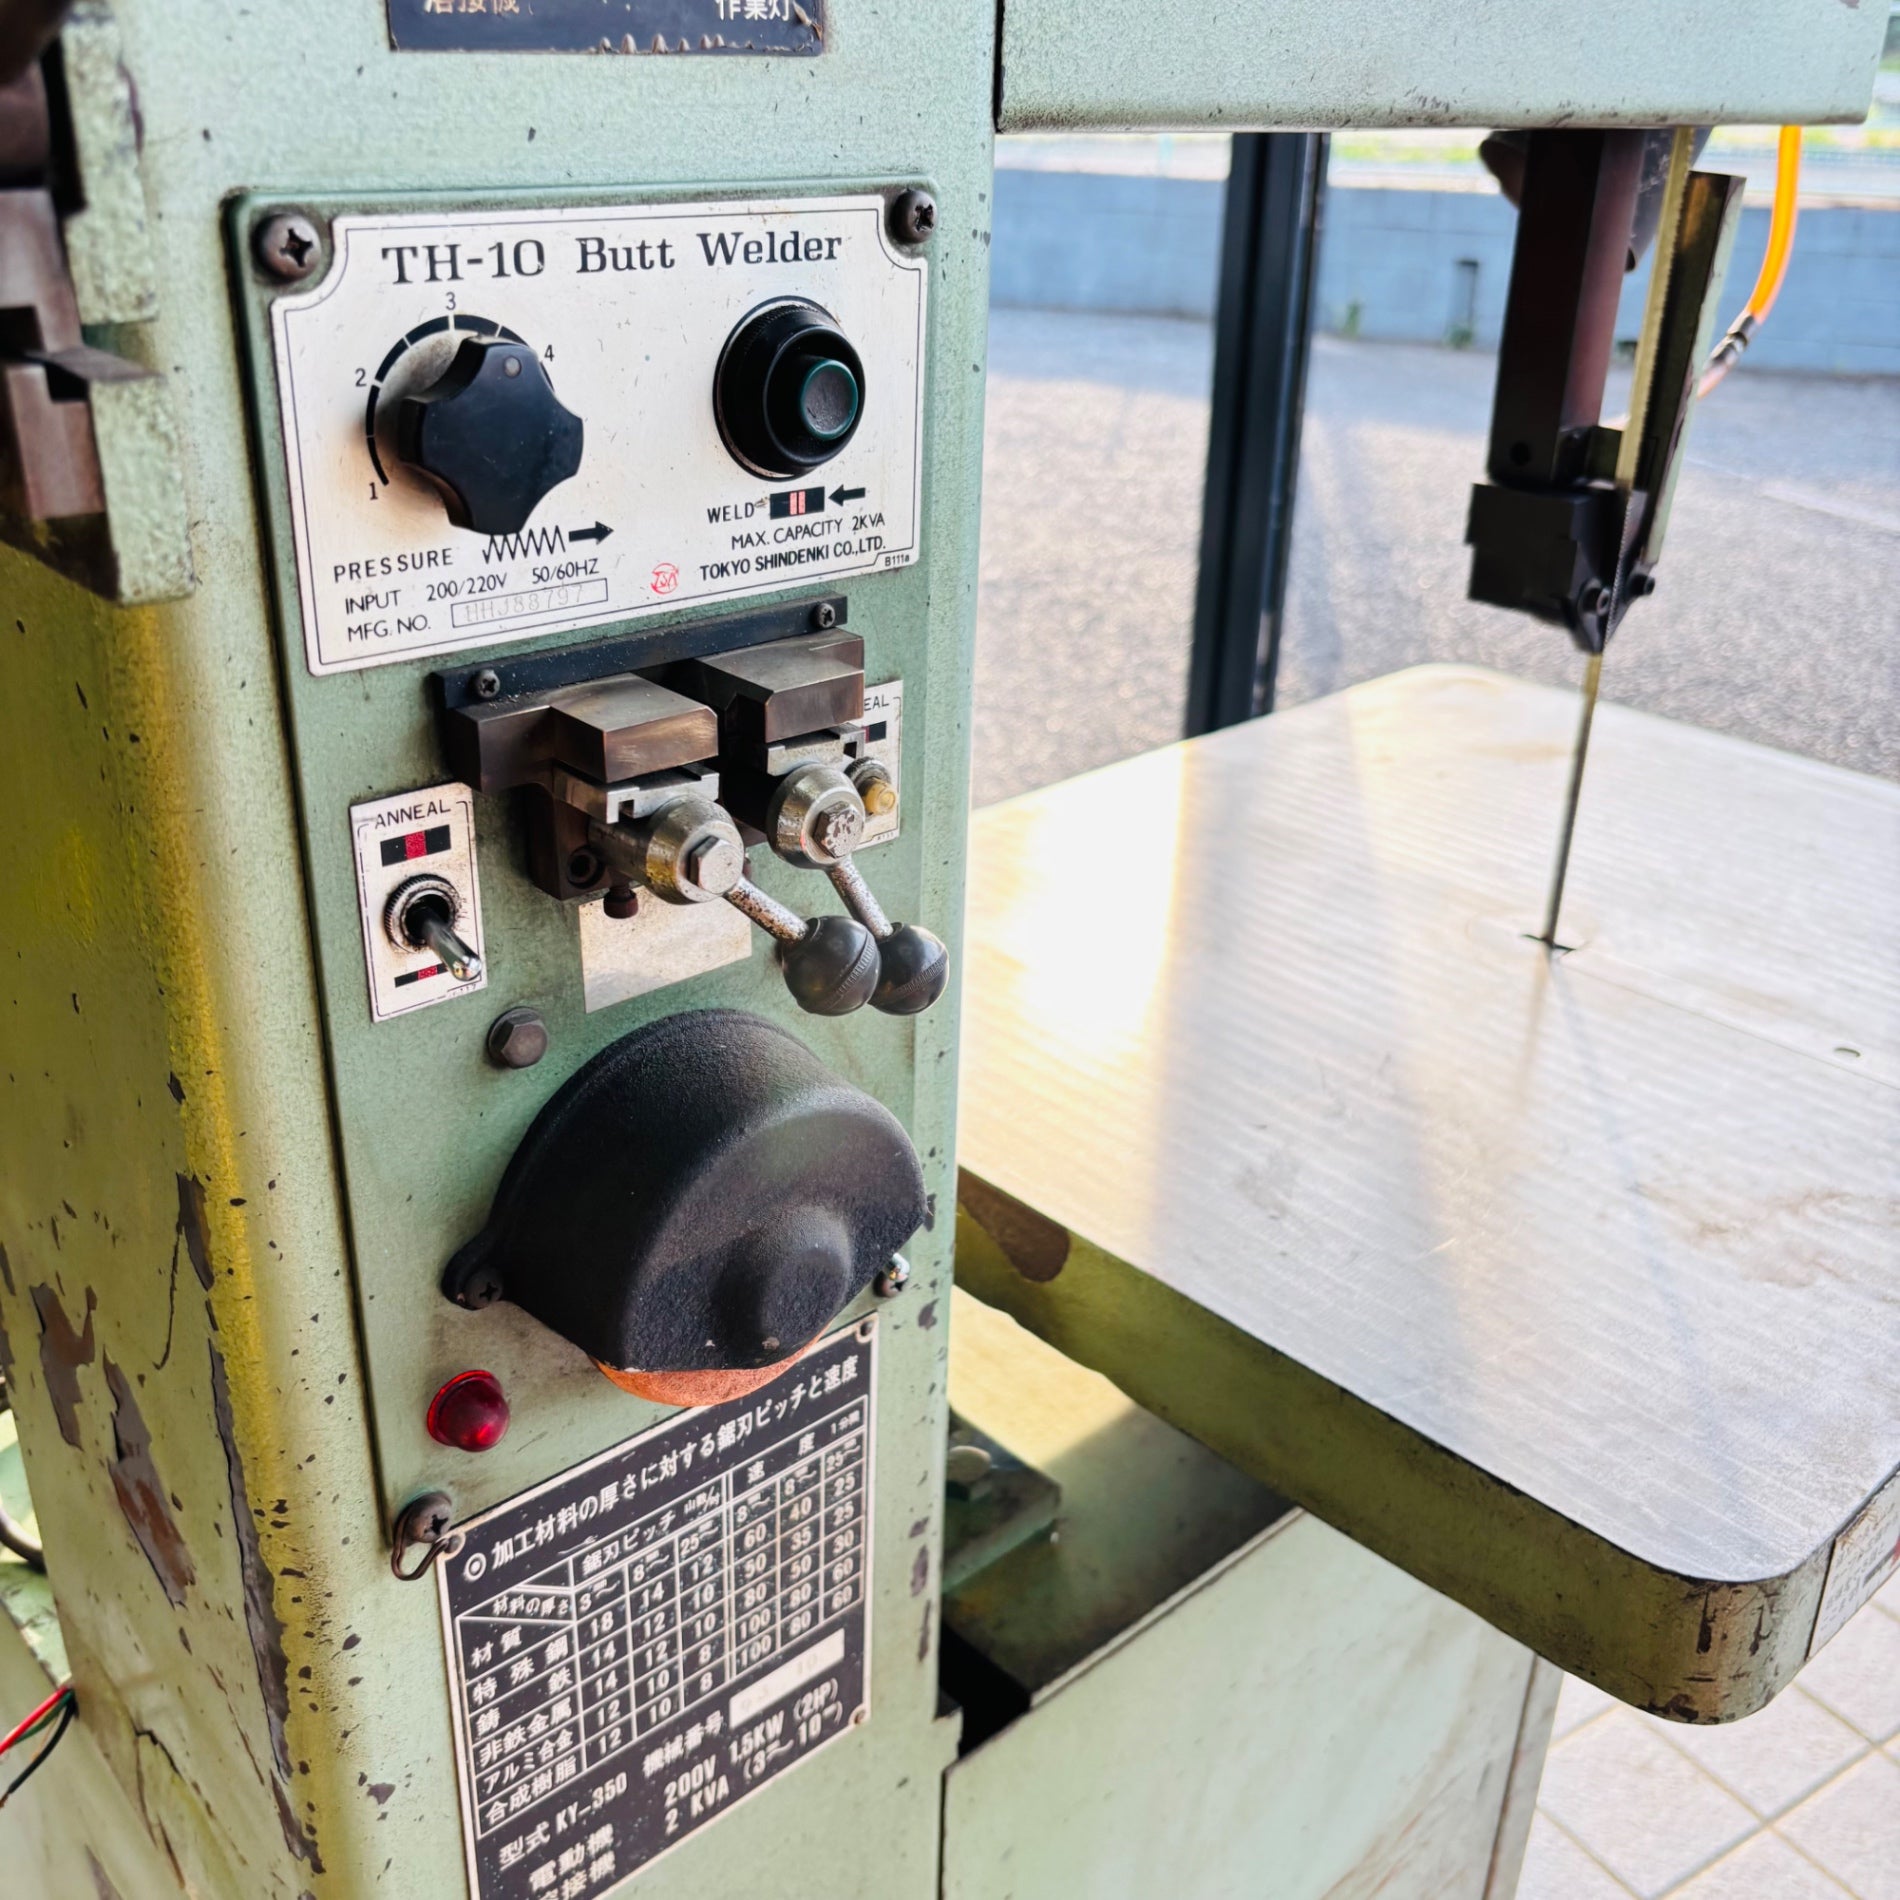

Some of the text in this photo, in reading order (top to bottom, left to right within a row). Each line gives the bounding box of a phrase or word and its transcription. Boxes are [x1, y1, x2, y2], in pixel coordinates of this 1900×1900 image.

[381, 230, 843, 285] TH-10 Butt Welder
[445, 292, 456, 311] 3
[544, 344, 555, 362] 4
[354, 368, 367, 388] 2
[369, 482, 379, 501] 1
[707, 501, 755, 524] WELD
[731, 511, 886, 550] MAX. CAPACITY 2KVA
[333, 548, 454, 583] PRESSURE
[700, 557, 751, 581] TOKYO
[754, 543, 830, 572] SHINDENKI
[833, 535, 887, 559] CO.,LTD.
[345, 558, 600, 614] INPUT 200/220V 50/60HZ
[348, 619, 394, 642] MFG.
[397, 613, 432, 635] NO.
[864, 695, 890, 712] EAL
[375, 799, 452, 830] ANNEAL
[590, 1610, 614, 1639] 18
[641, 1580, 665, 1610] 14
[690, 1553, 714, 1582] 12
[743, 1522, 767, 1549] 60
[789, 1496, 812, 1522] 40
[833, 1471, 856, 1498] 25
[592, 1640, 617, 1670] 14
[643, 1611, 666, 1640] 12
[692, 1582, 715, 1611] 10
[744, 1552, 767, 1579] 50
[791, 1525, 812, 1551] 35
[833, 1500, 855, 1527] 25
[596, 1669, 618, 1699] 14
[645, 1640, 668, 1669] 12
[694, 1611, 717, 1640] 10
[790, 1554, 812, 1581] 50
[483, 1728, 574, 1795] アルミ合金
[598, 1698, 621, 1728] 12
[648, 1669, 670, 1699] 10
[700, 1643, 712, 1666] 8
[740, 1607, 771, 1641] 100
[832, 1557, 854, 1584] 60
[485, 1755, 578, 1825] 合成樹脂
[600, 1727, 622, 1756] 12
[650, 1697, 672, 1726] 10
[700, 1671, 713, 1693] 8
[740, 1634, 772, 1667] 100
[831, 1585, 853, 1611] 60
[664, 1754, 717, 1808] 200V
[664, 1808, 680, 1836] 2
[690, 1774, 730, 1819] KVA
[499, 1820, 551, 1871] 型式
